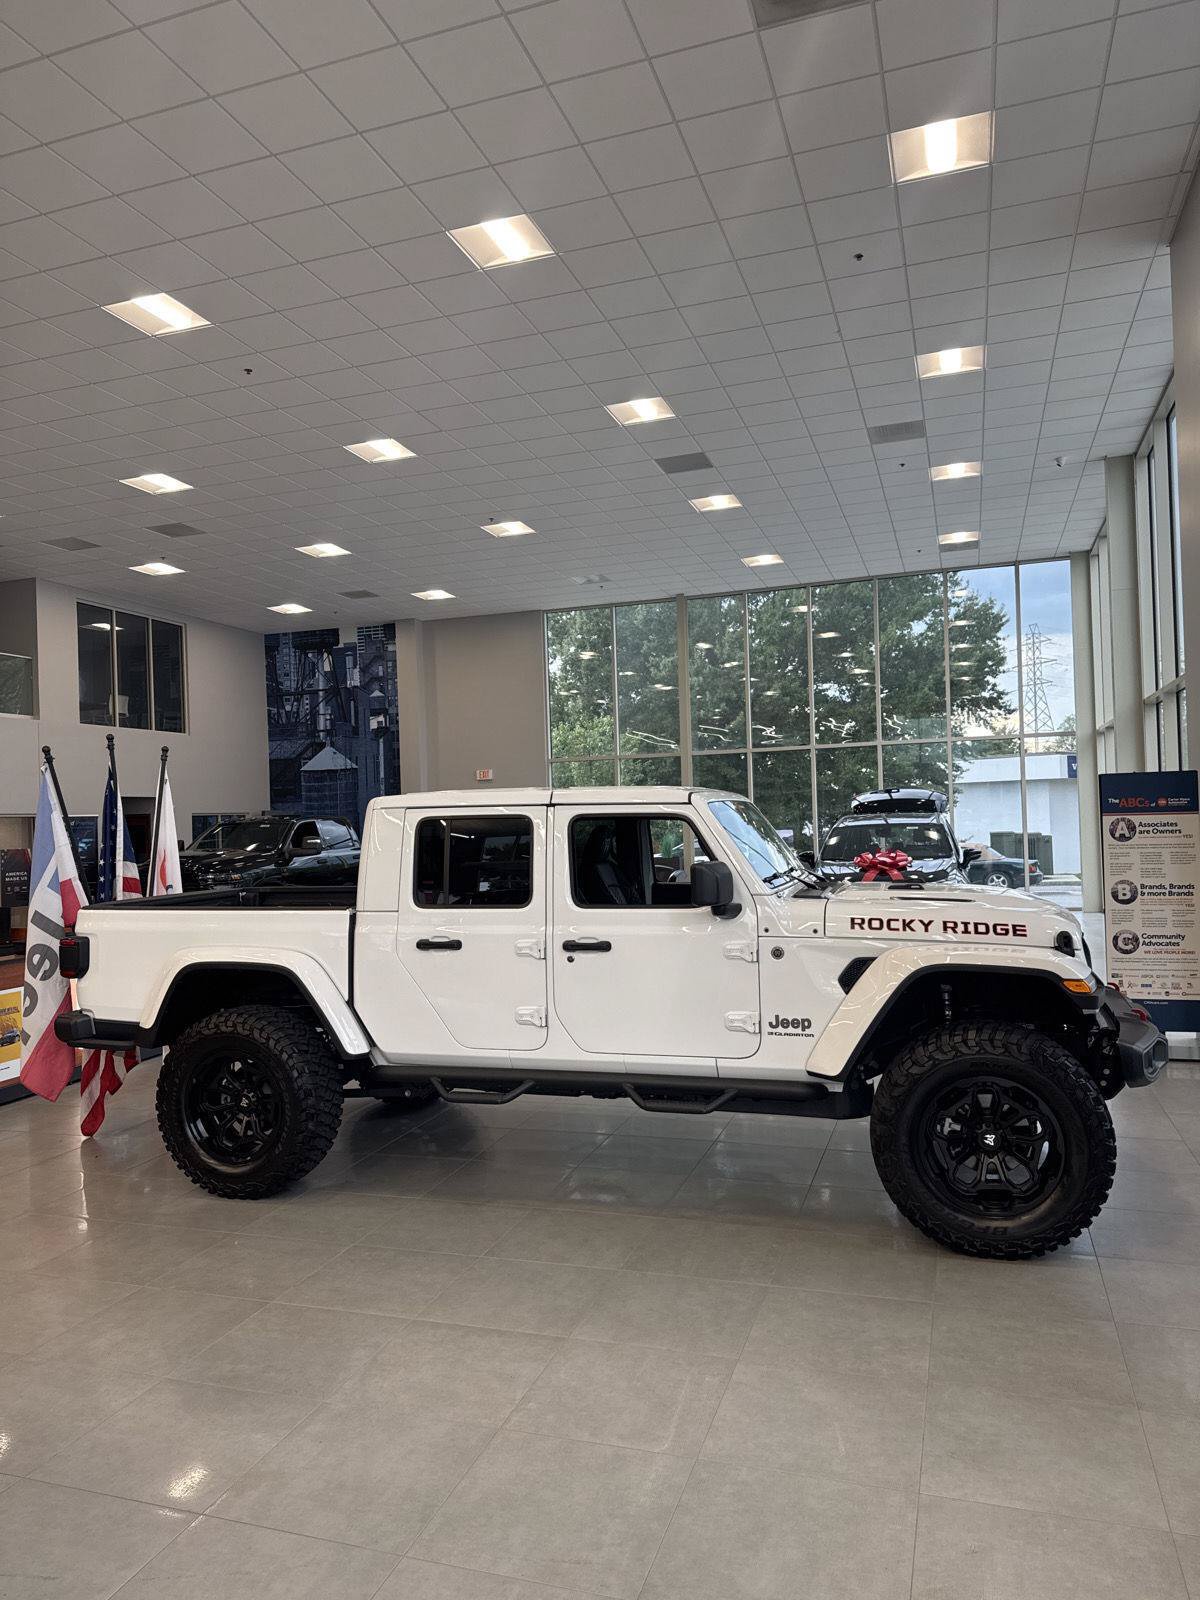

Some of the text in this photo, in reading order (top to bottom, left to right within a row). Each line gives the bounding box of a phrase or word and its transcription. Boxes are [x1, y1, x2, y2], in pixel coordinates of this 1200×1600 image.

[1119, 797, 1150, 807] ABCs
[1114, 821, 1131, 838] A
[1117, 883, 1132, 900] B
[850, 917, 1028, 937] ROCKY RIDGE
[1141, 933, 1186, 941] Community
[768, 1014, 812, 1032] Jeep
